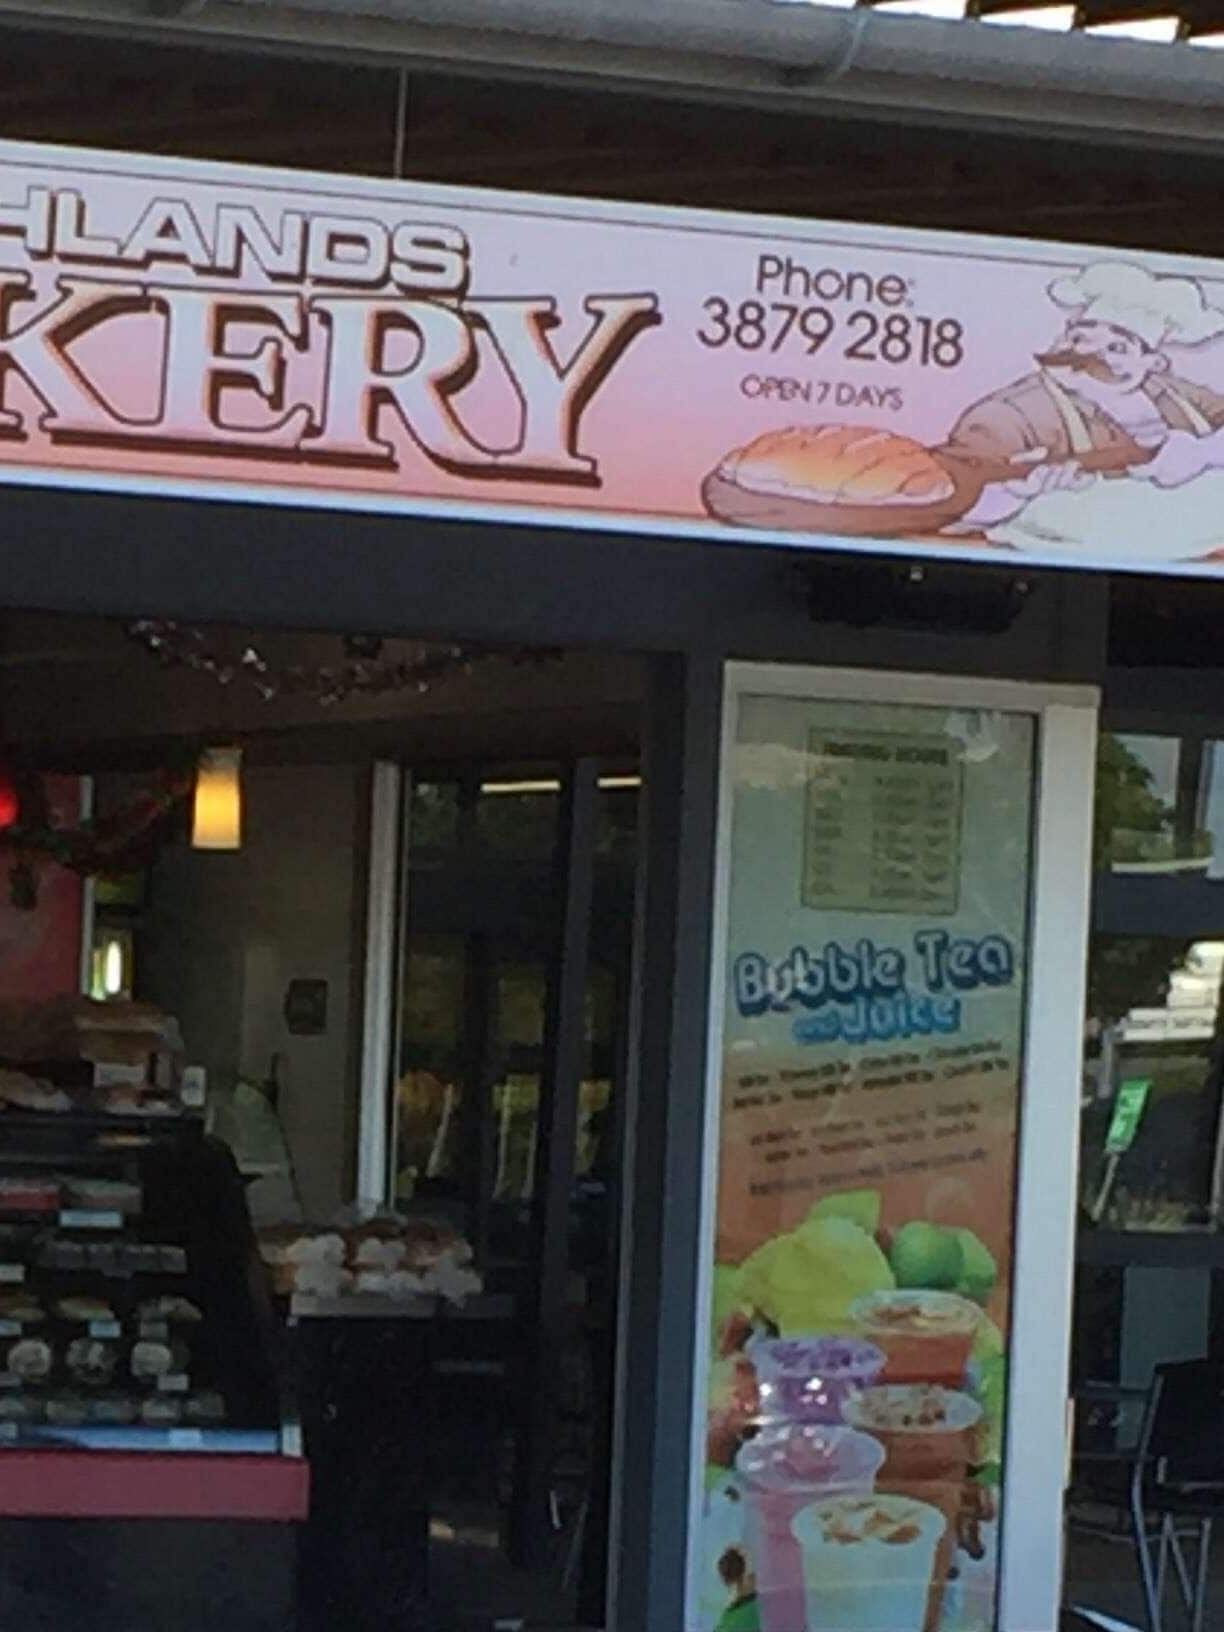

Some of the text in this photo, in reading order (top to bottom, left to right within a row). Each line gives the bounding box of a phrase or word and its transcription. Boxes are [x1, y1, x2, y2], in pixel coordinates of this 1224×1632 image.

[696, 295, 964, 368] 3879 2818
[739, 373, 904, 411] OPEN 7 DAYS
[734, 928, 1014, 1016] Bubble Tea
